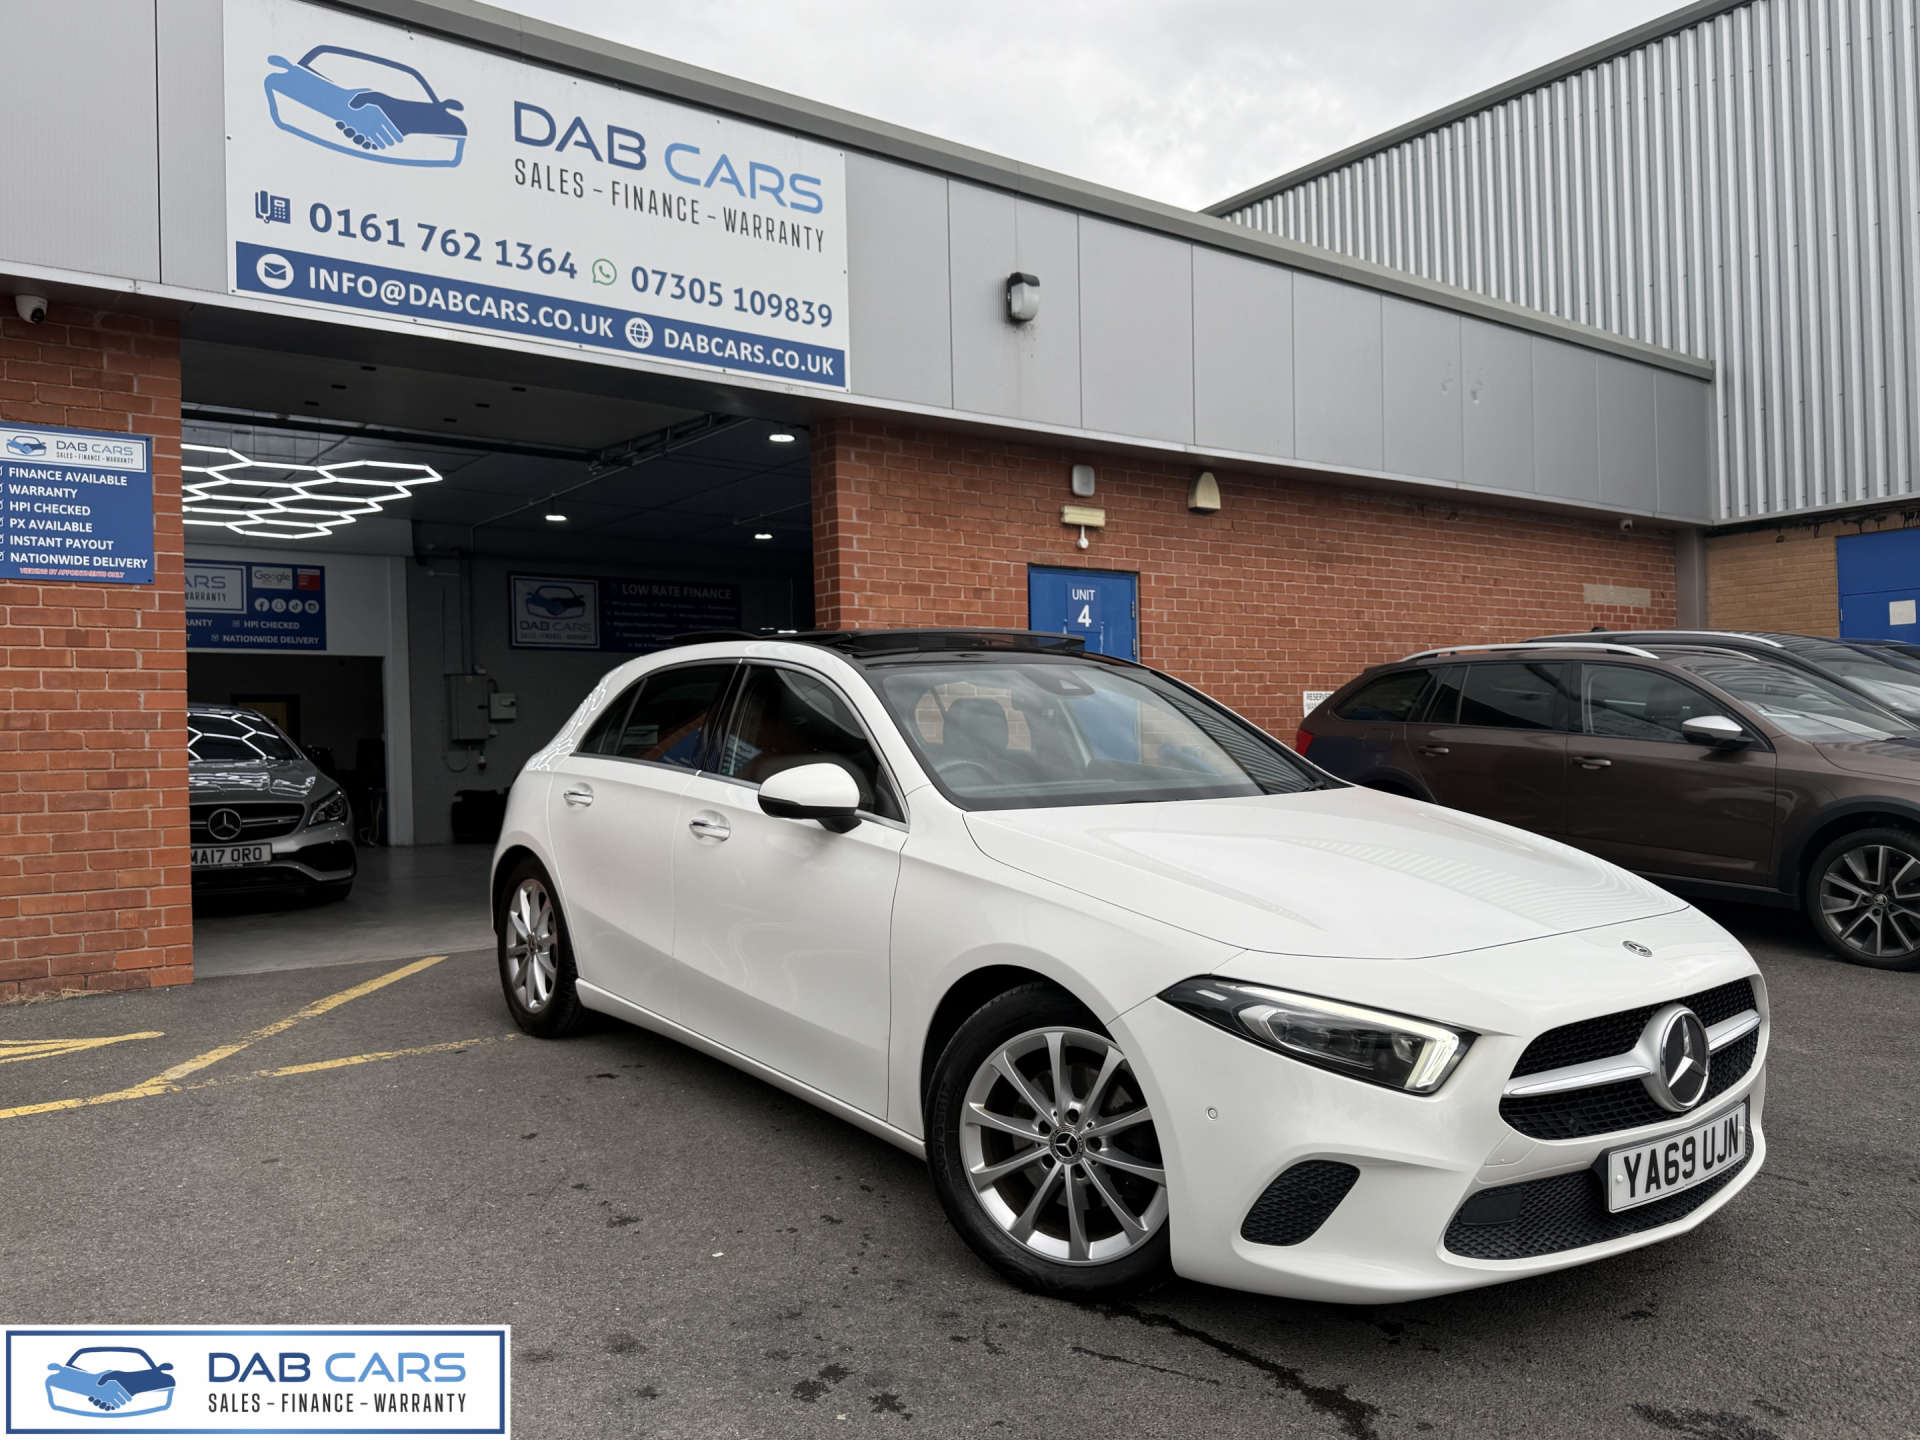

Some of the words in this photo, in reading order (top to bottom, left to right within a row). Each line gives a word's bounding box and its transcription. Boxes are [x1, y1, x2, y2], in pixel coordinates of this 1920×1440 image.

[513, 100, 647, 171] DAB
[664, 142, 823, 214] CARS
[514, 159, 584, 199] SALES
[611, 181, 700, 225] FINANCE
[722, 207, 825, 253] WARRANTY
[309, 202, 405, 248] 0161
[417, 223, 482, 262] 762
[495, 239, 578, 280] 1364
[631, 266, 724, 307] 07305
[733, 287, 833, 328] 109839
[308, 266, 613, 339] INFO@DABCARS.CO.UK
[664, 328, 834, 375] DABCARS.CO.UK
[56, 440, 88, 452] DAB
[92, 444, 134, 456] CARS
[9, 467, 62, 481] FINANCE
[65, 472, 128, 486] AVAILABLE
[9, 484, 78, 499] WARRANTY
[10, 501, 31, 512] HPI
[34, 503, 91, 516] CHECKED
[10, 518, 26, 529] PX
[29, 520, 93, 533] AVAILABLE
[10, 535, 62, 548] INSTANT
[66, 538, 114, 551] PAYOUT
[10, 553, 89, 566] NATIONWIDE
[93, 557, 148, 569] DELIVERY
[185, 575, 226, 589] ARS
[621, 583, 649, 596] LOW
[652, 585, 681, 598] RATE
[683, 587, 732, 600] FINANCE
[1071, 588, 1096, 601] UNIT
[1077, 604, 1092, 628] 4
[519, 620, 549, 631] DAB
[223, 634, 280, 644] NATIONWIDE
[280, 636, 319, 645] DELIVERY
[1623, 1136, 1696, 1198] YA69
[1703, 1114, 1739, 1170] UJN
